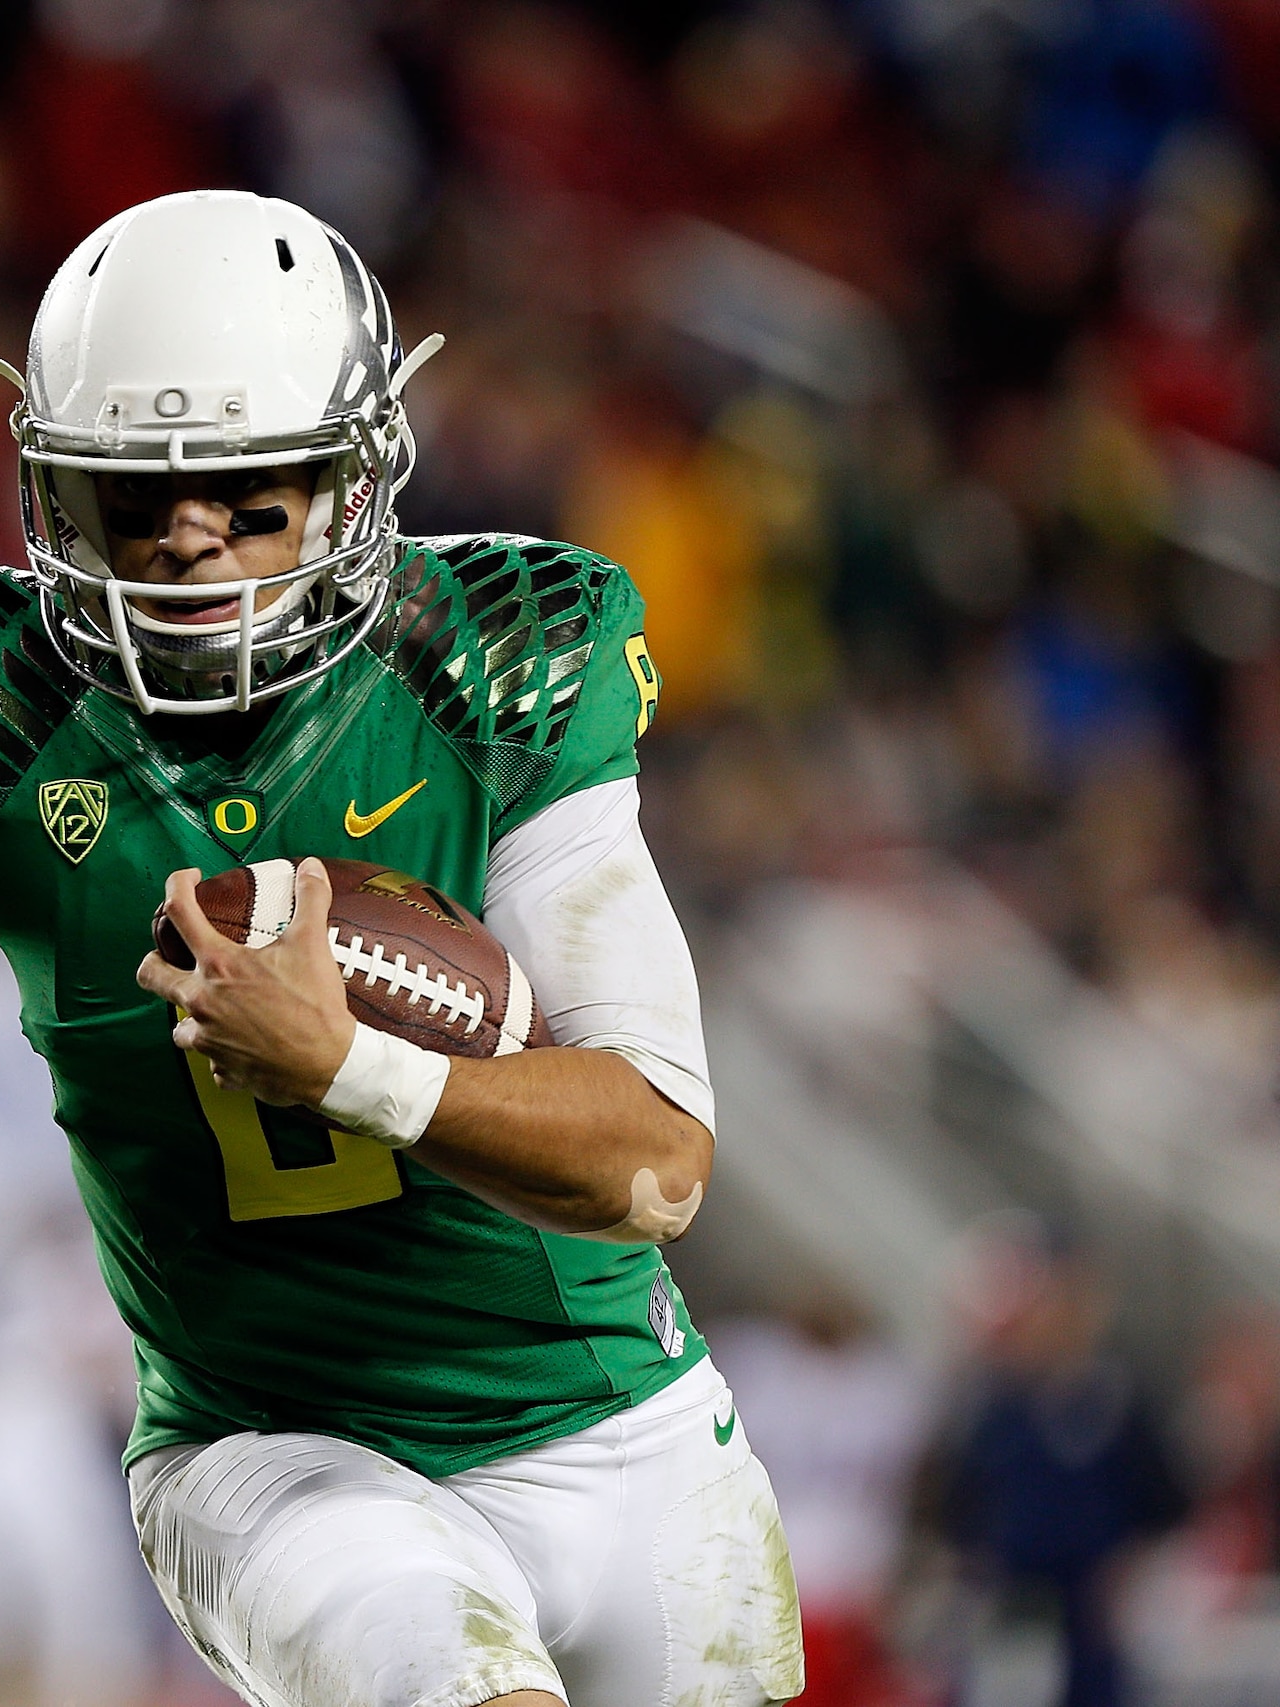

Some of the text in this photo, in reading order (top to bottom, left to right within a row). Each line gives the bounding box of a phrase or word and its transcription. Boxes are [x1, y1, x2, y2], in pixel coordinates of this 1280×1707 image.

[154, 387, 192, 418] O
[43, 782, 104, 829] PAC
[214, 797, 257, 834] O
[59, 814, 91, 845] 12
